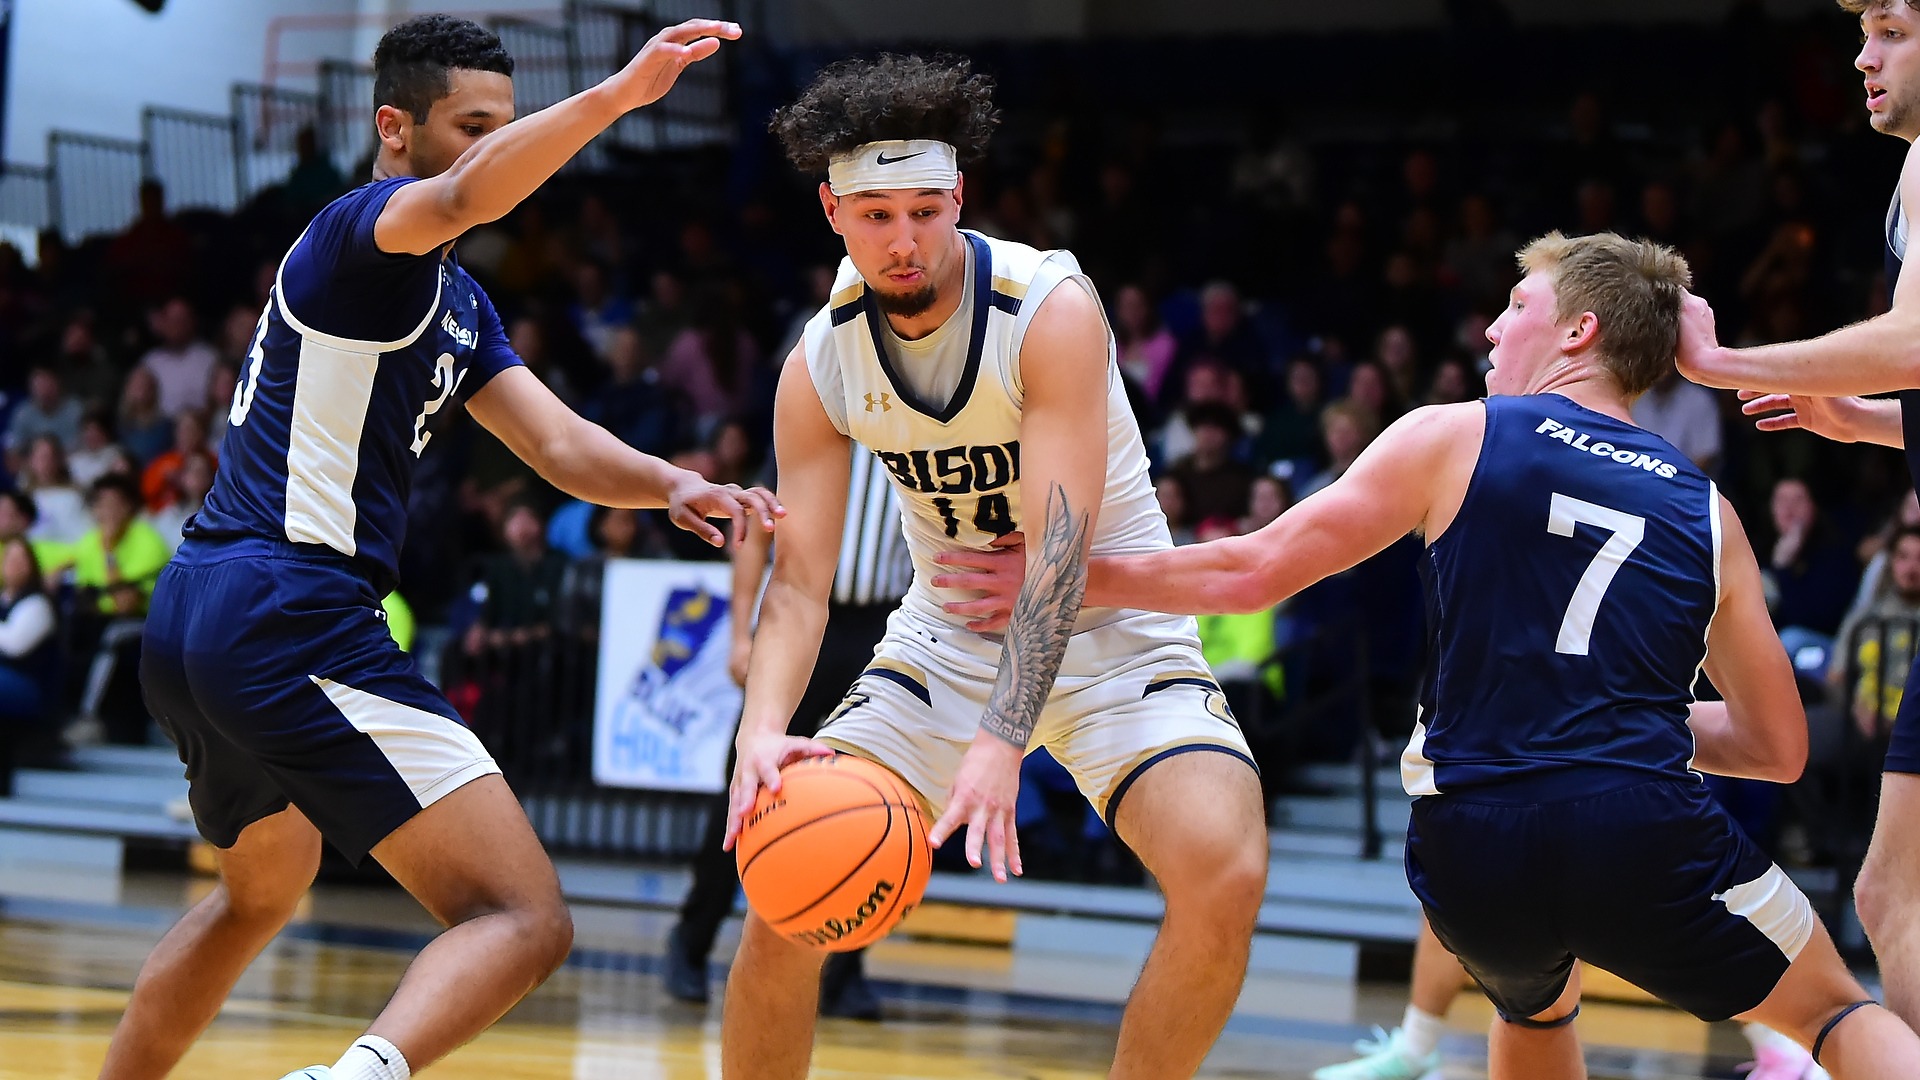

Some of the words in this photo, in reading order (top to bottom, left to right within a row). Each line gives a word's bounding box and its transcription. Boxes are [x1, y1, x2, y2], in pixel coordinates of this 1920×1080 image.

[1535, 417, 1678, 479] FALCONS
[931, 493, 1017, 540] 14
[1547, 491, 1646, 656] 7
